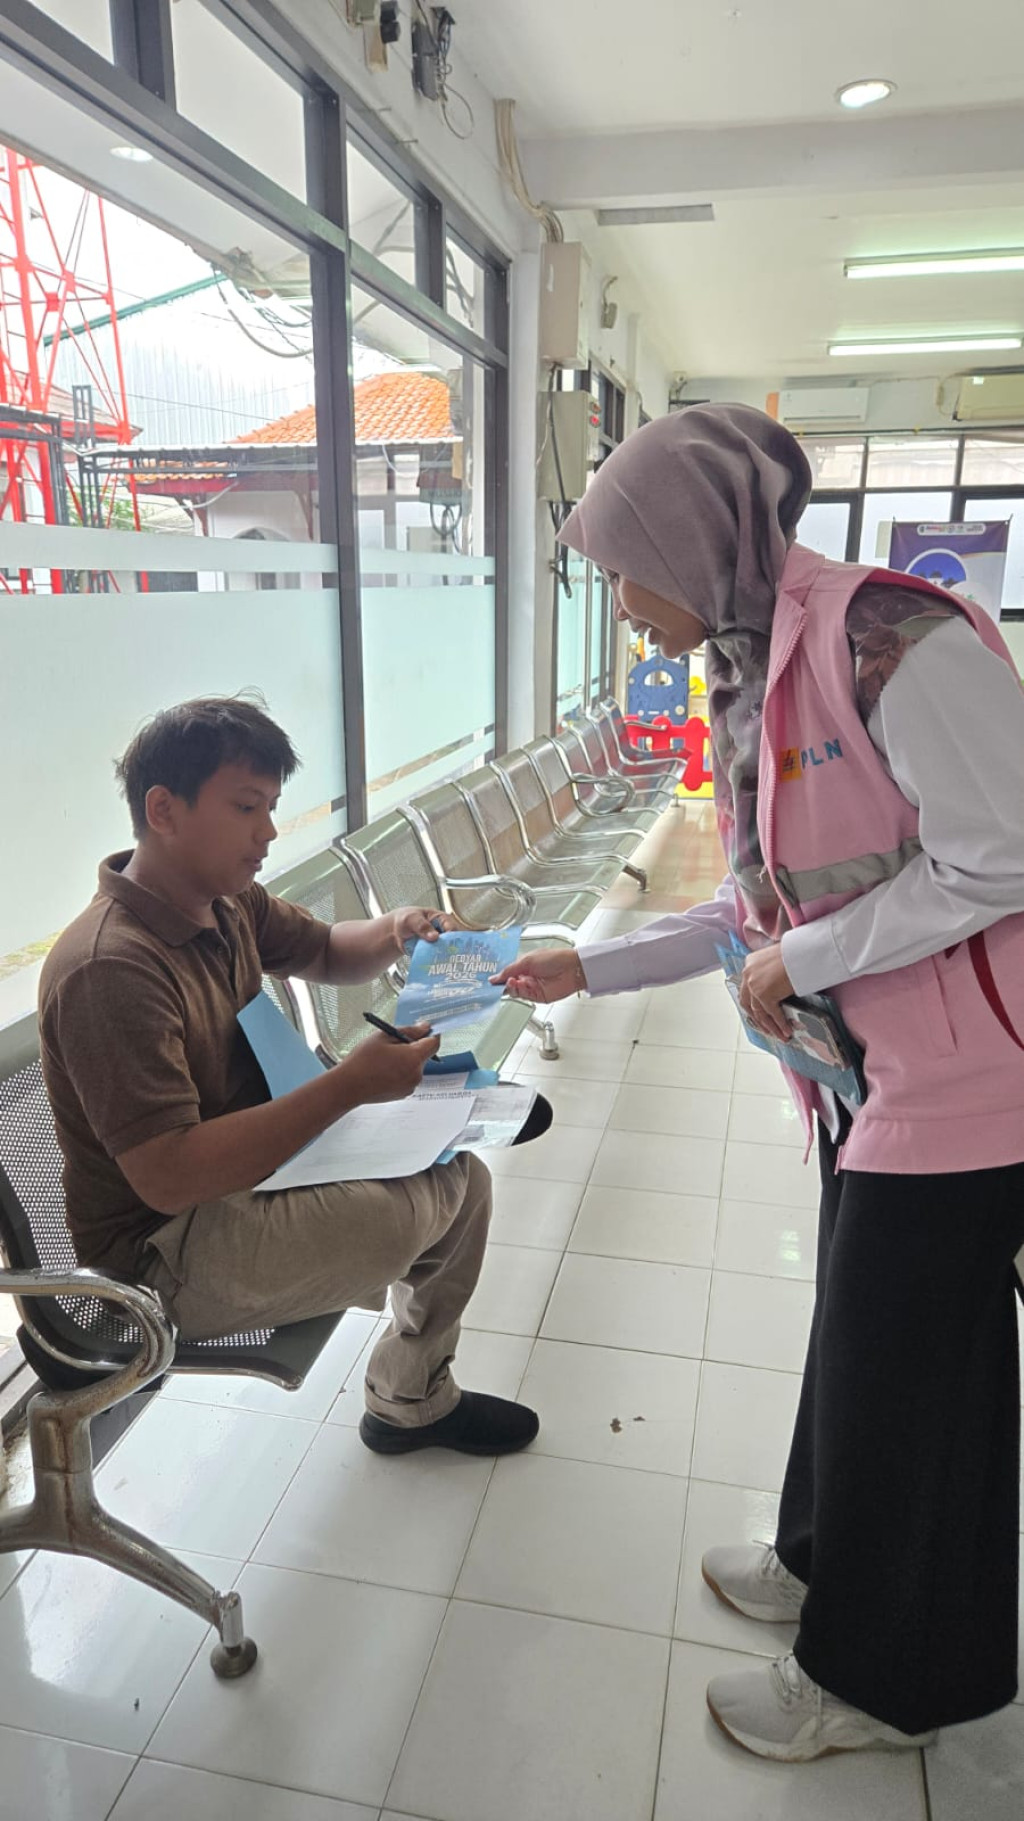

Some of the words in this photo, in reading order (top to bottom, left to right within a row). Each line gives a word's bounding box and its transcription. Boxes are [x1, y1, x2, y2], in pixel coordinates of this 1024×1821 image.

[801, 738, 843, 770] PLN
[428, 963, 459, 975] AWAL
[462, 961, 498, 974] TAHUN
[445, 972, 477, 980] 2026
